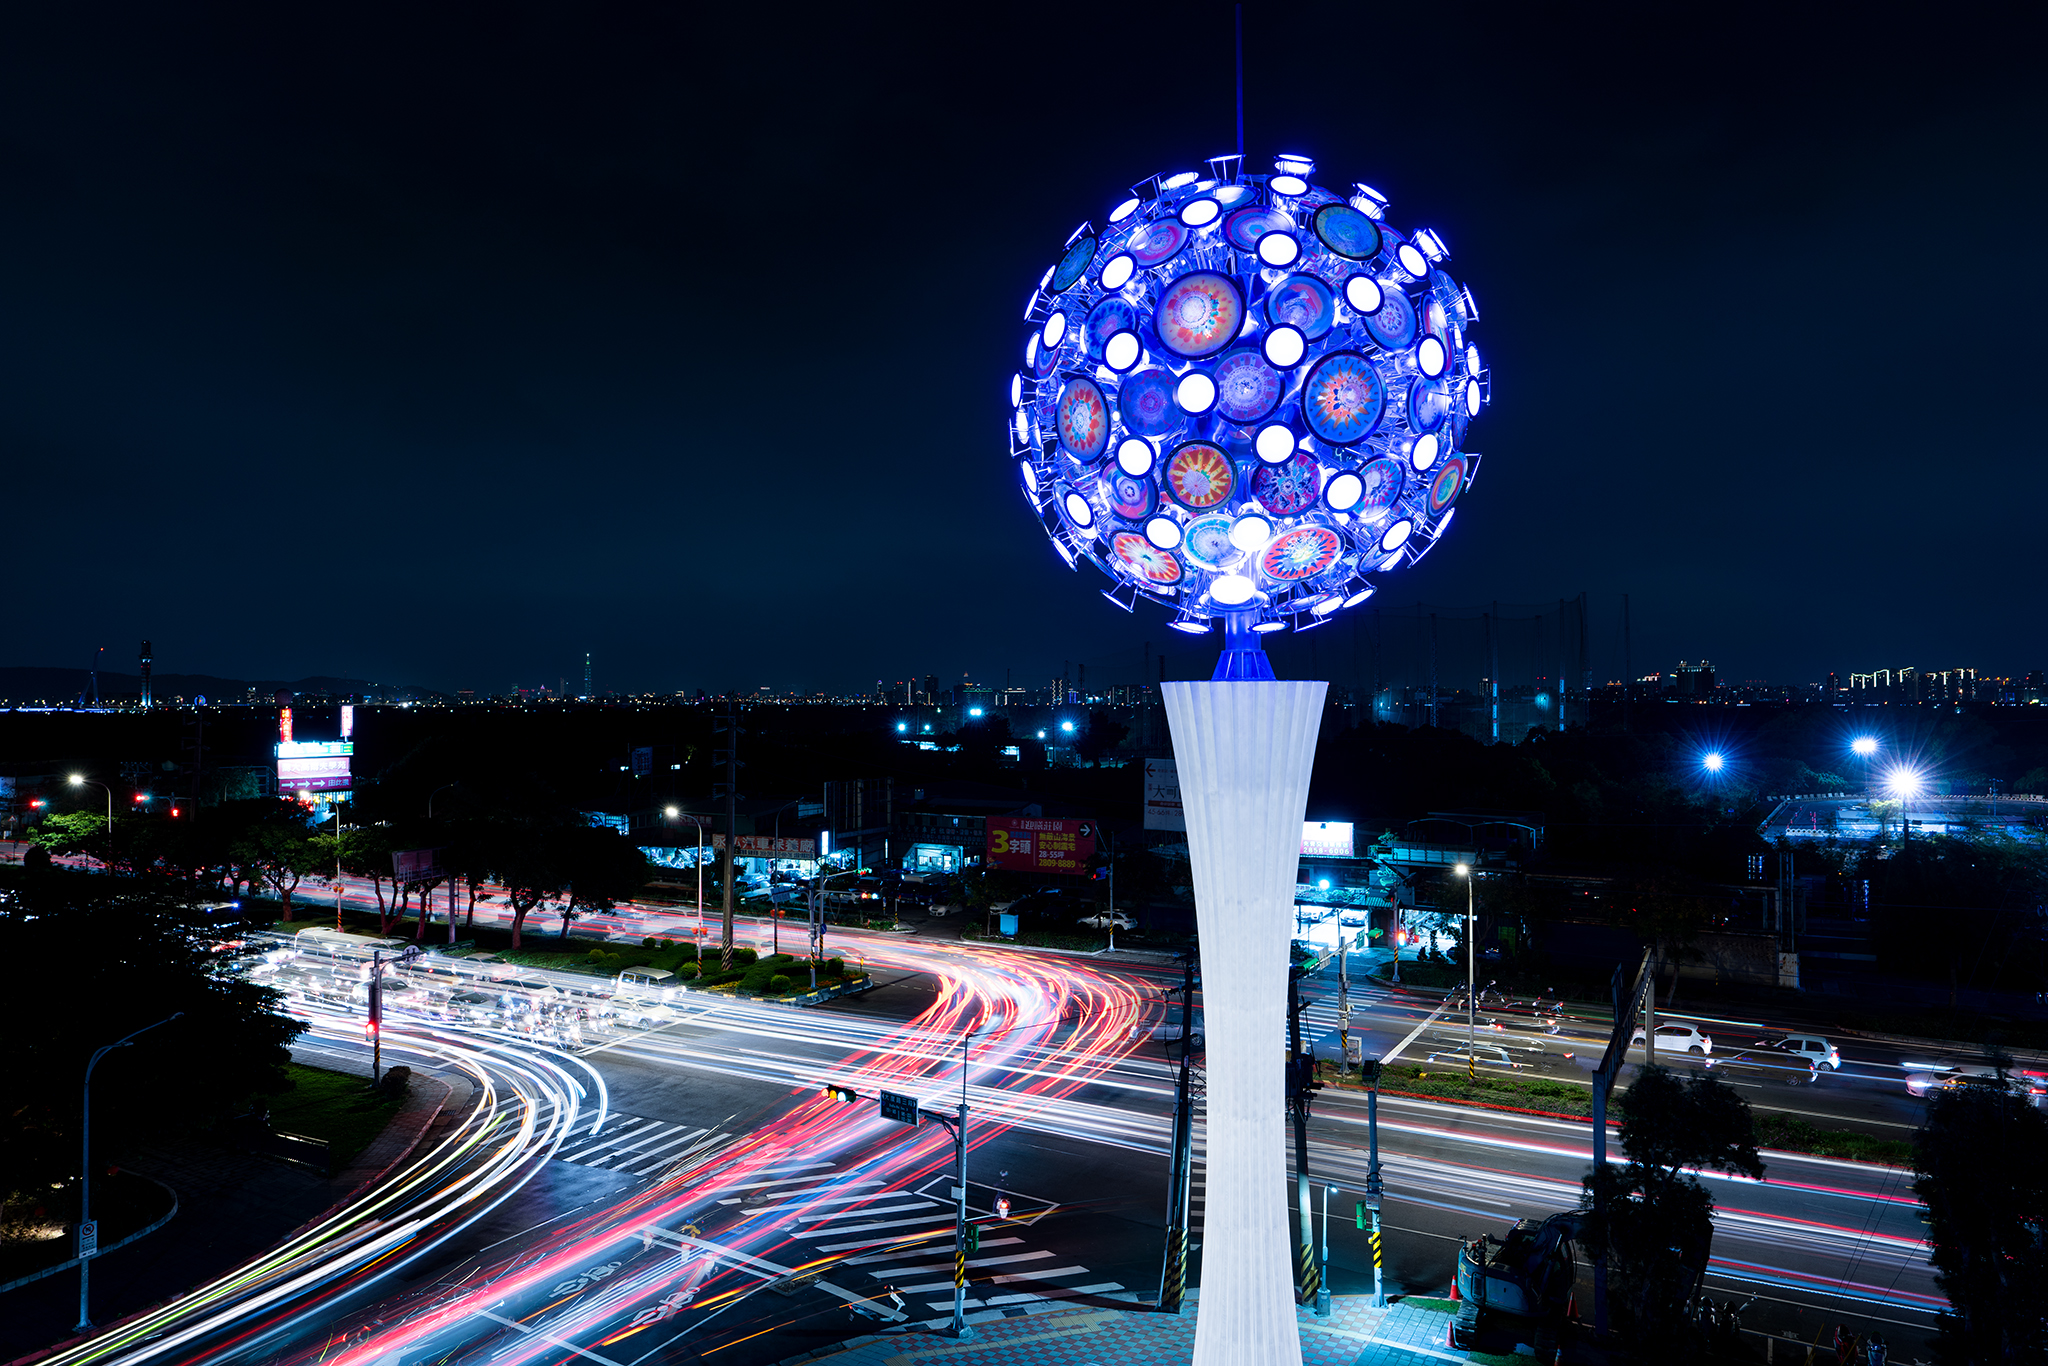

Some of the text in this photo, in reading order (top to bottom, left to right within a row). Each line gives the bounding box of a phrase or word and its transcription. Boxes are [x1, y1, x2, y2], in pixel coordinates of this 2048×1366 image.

[1153, 785, 1181, 799] 大可
[1038, 832, 1076, 842] 無敵山海景
[1038, 850, 1065, 859] 28-55坪
[1303, 847, 1349, 855] 2858-6006
[1038, 859, 1076, 868] 2809-8889
